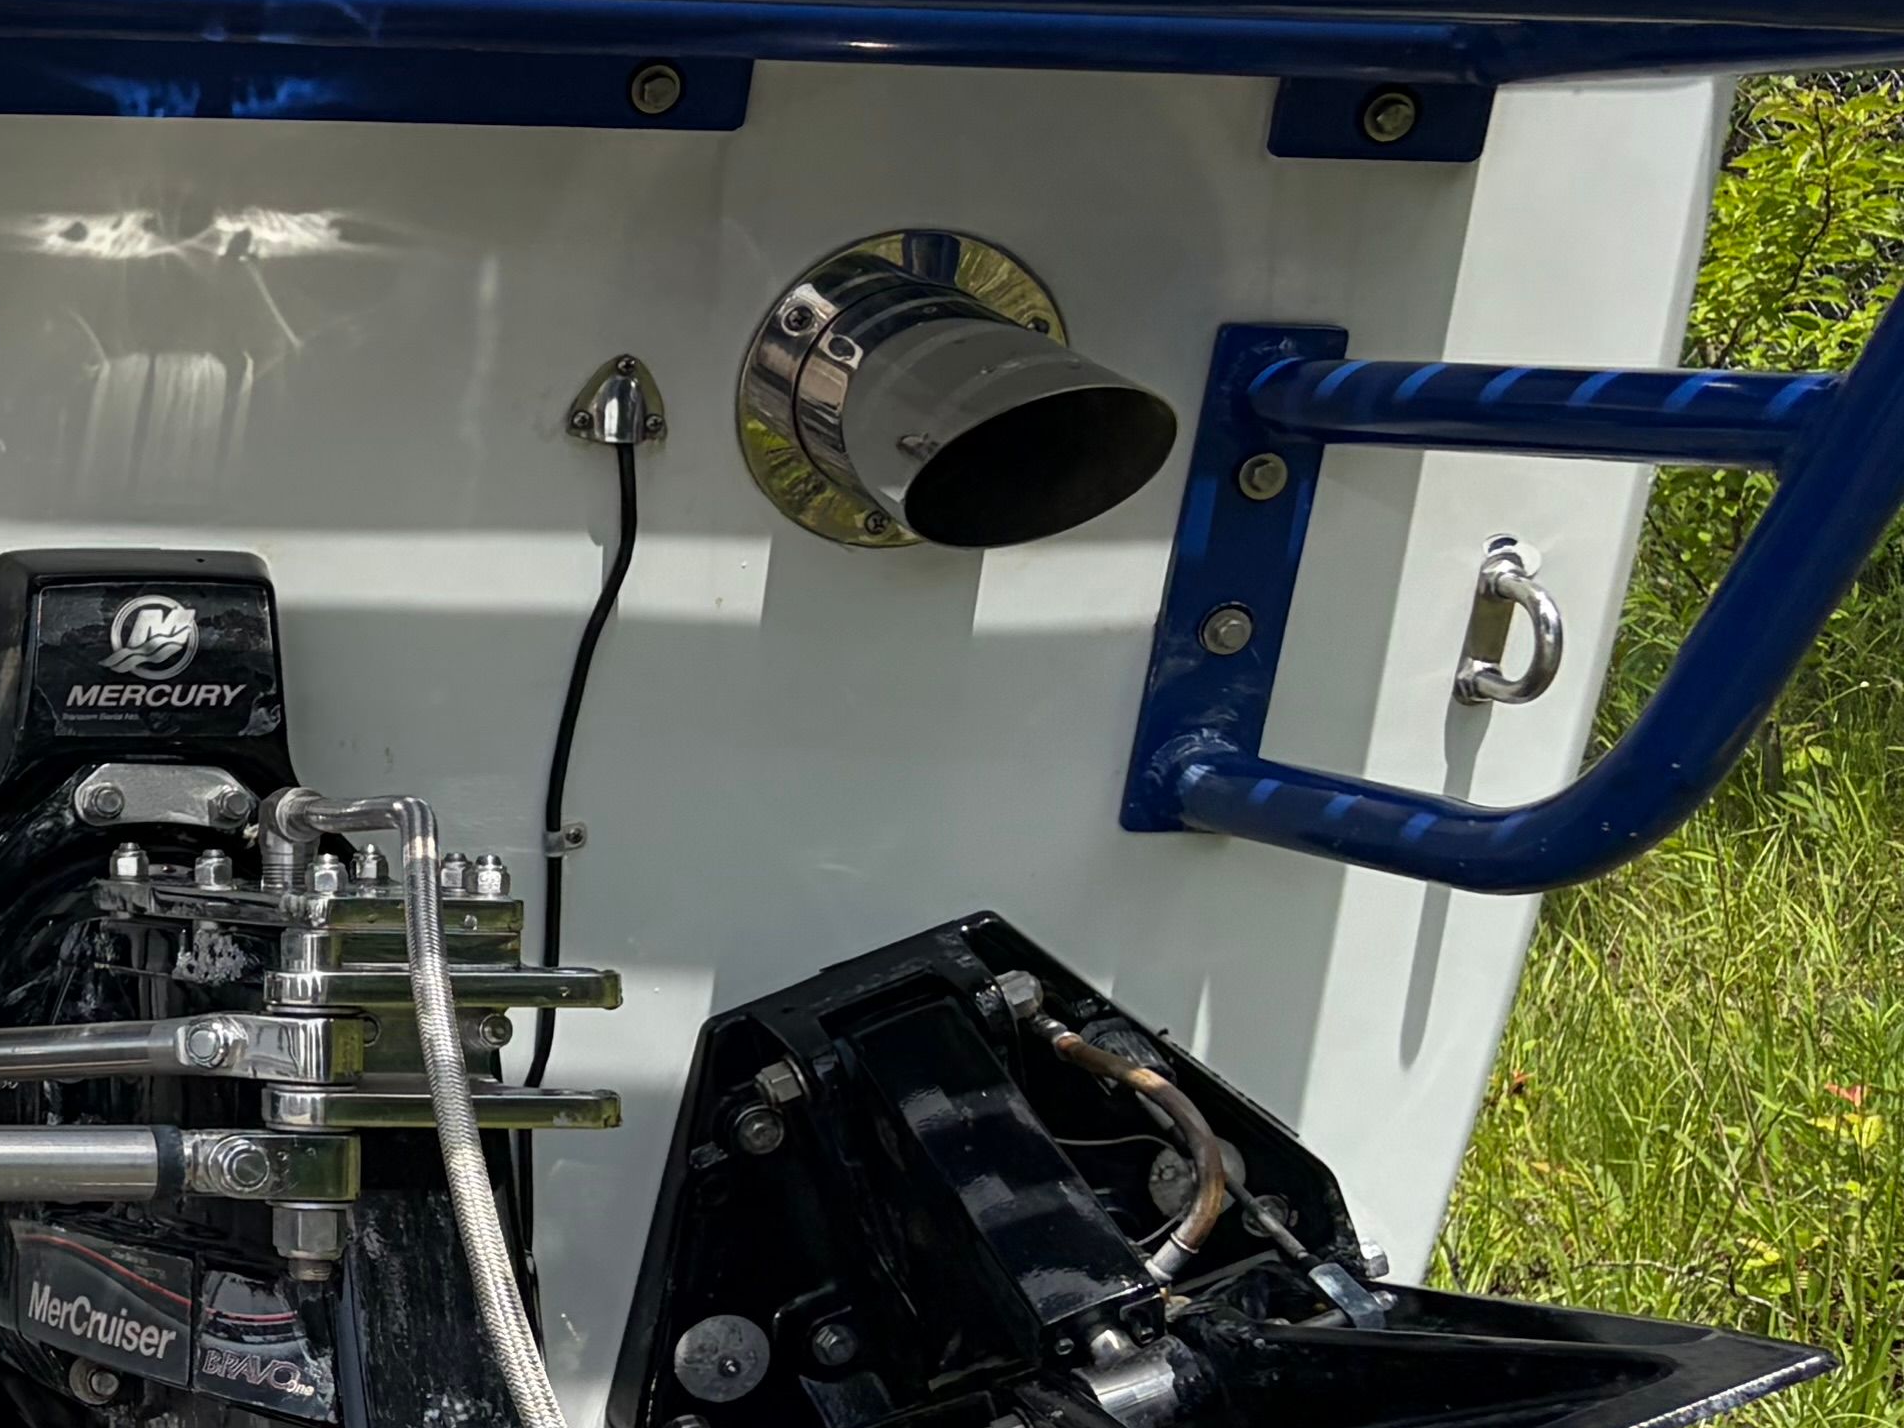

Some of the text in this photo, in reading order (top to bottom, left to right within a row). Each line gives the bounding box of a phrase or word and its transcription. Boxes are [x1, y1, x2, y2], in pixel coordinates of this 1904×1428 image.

[65, 683, 247, 708] MERCURY
[27, 1280, 177, 1360] MerCruiser
[201, 1349, 301, 1390] BRAVO
